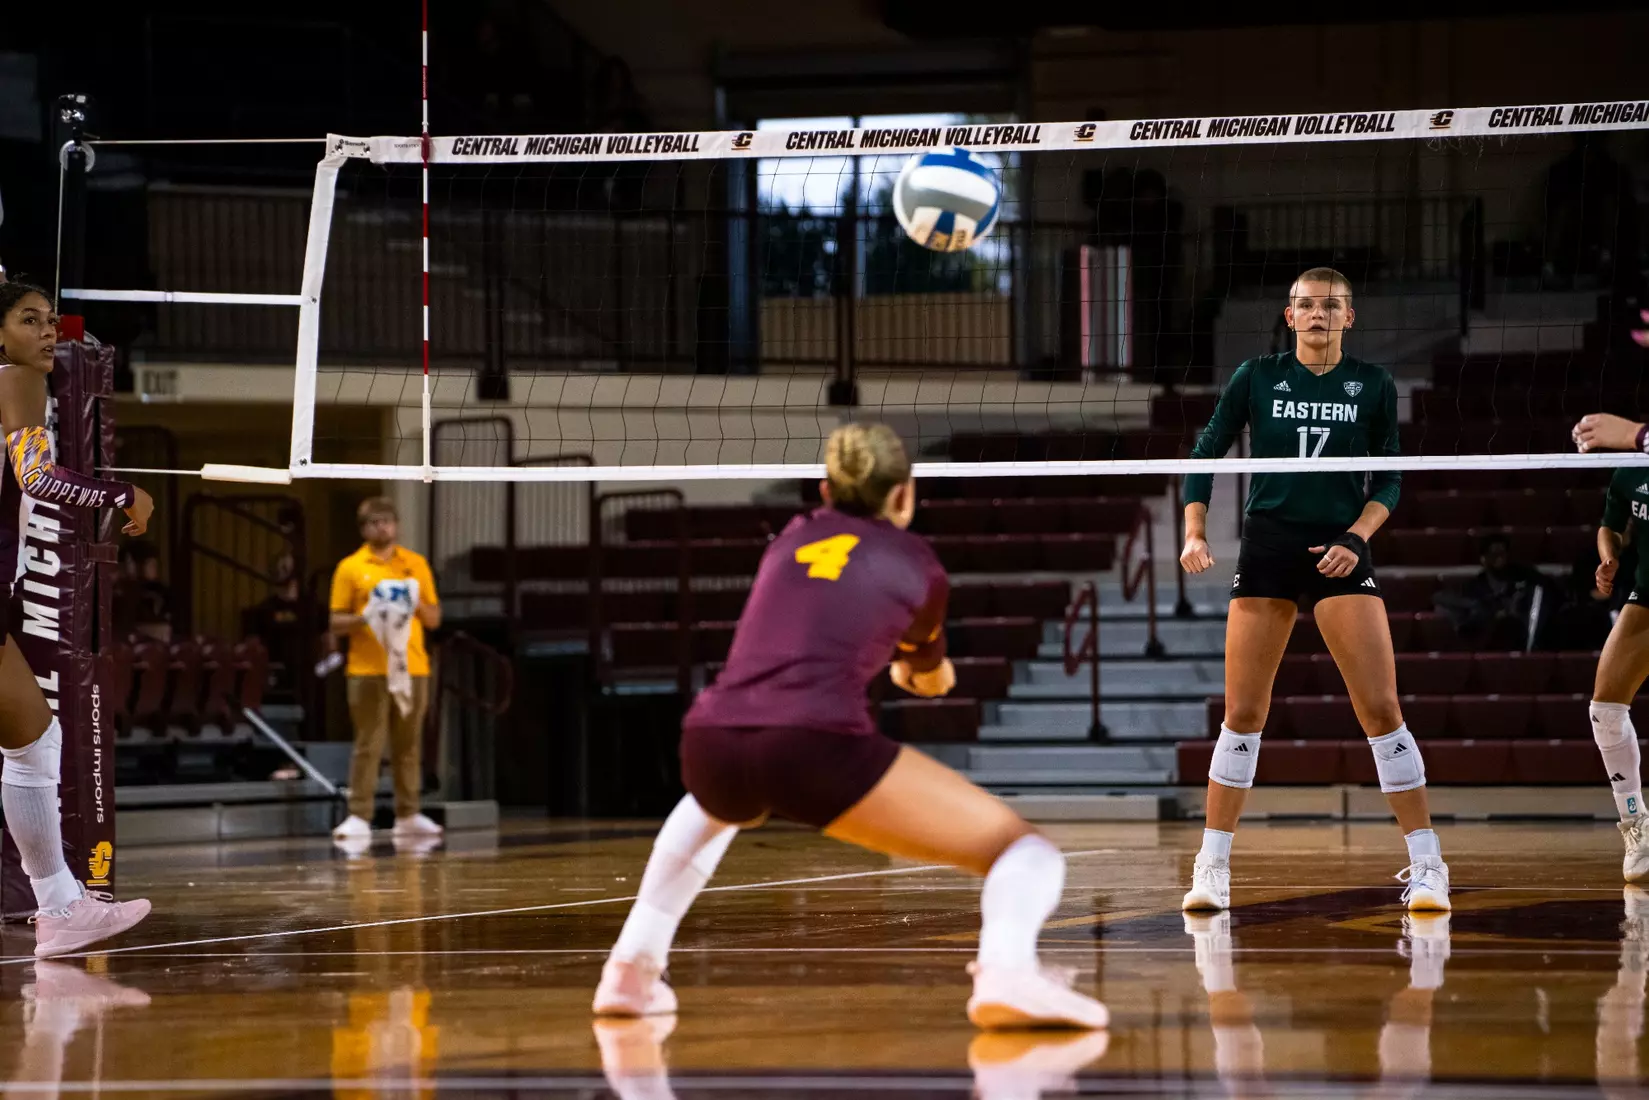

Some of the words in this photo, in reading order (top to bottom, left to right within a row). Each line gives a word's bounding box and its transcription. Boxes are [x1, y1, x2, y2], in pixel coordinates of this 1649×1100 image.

[1129, 120, 1201, 140] CENTRAL
[1206, 117, 1292, 138] MICHIGAN
[1294, 113, 1396, 136] VOLLEYBALL
[1488, 106, 1563, 128] CENTRAL
[451, 137, 519, 156] CENTRAL
[523, 136, 603, 155] MICHIGAN
[606, 134, 700, 154] VOLLEYBALL
[785, 130, 855, 150] CENTRAL
[859, 128, 941, 148] MICHIGAN
[944, 125, 1041, 146] VOLLEYBALL
[1272, 400, 1358, 423] EASTERN
[1296, 426, 1331, 459] 17
[22, 467, 107, 508] CHIPPEWAS
[1631, 500, 1649, 521] EA
[795, 533, 861, 581] 4
[91, 683, 101, 748] sports
[91, 749, 104, 824] imports
